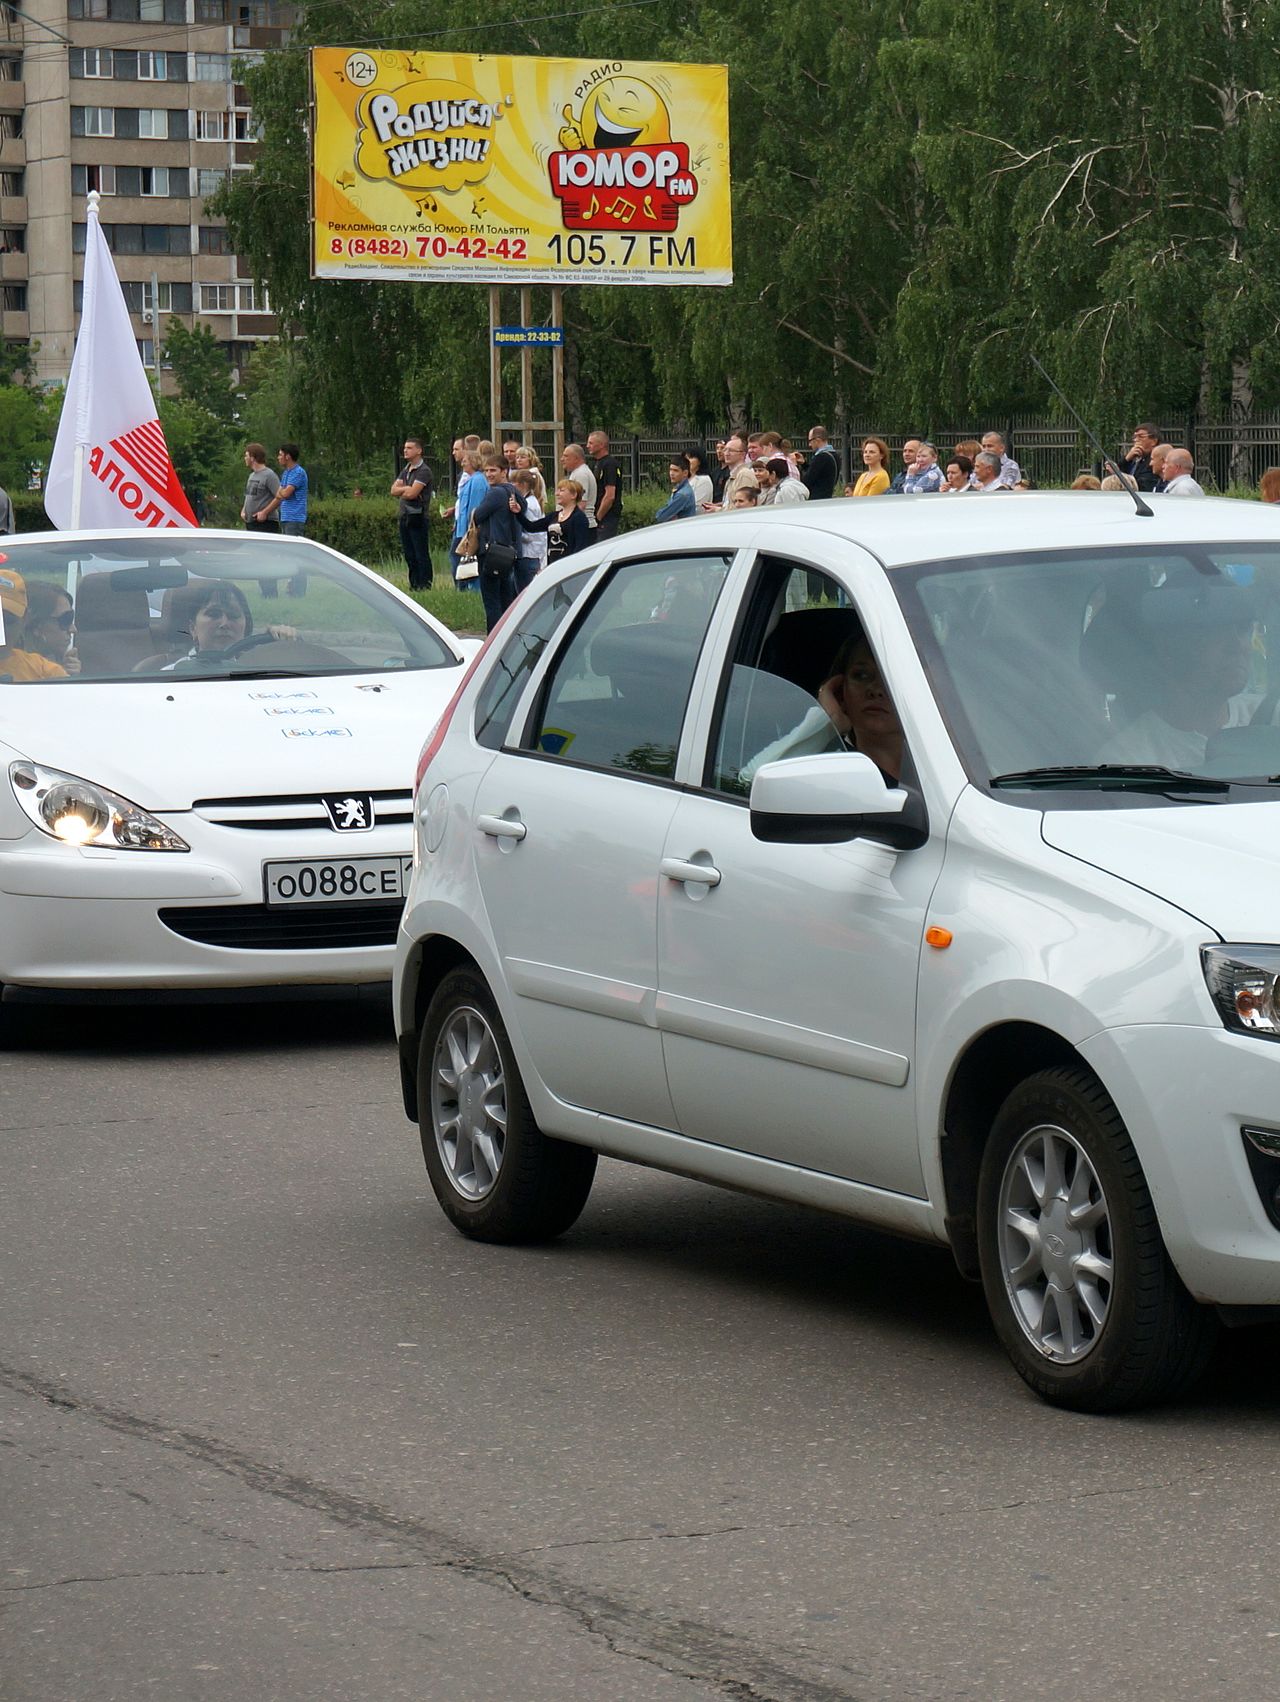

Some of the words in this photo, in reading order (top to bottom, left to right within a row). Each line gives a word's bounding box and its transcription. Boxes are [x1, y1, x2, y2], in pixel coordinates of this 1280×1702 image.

[347, 61, 375, 78] 12+
[575, 62, 623, 98] РАДИО
[559, 151, 679, 188] ЮМОР
[669, 179, 694, 196] FM
[328, 221, 387, 232] Рекламная
[390, 222, 432, 234] служба
[434, 224, 468, 235] Юмор
[470, 224, 484, 234] FM
[487, 225, 530, 235] Тольятти
[331, 238, 342, 253] 8
[348, 239, 408, 257] (8482)
[416, 237, 527, 259] 70-42-42
[547, 234, 637, 265] 105.7
[650, 236, 695, 266] FM
[89, 446, 180, 527] АПОЛ
